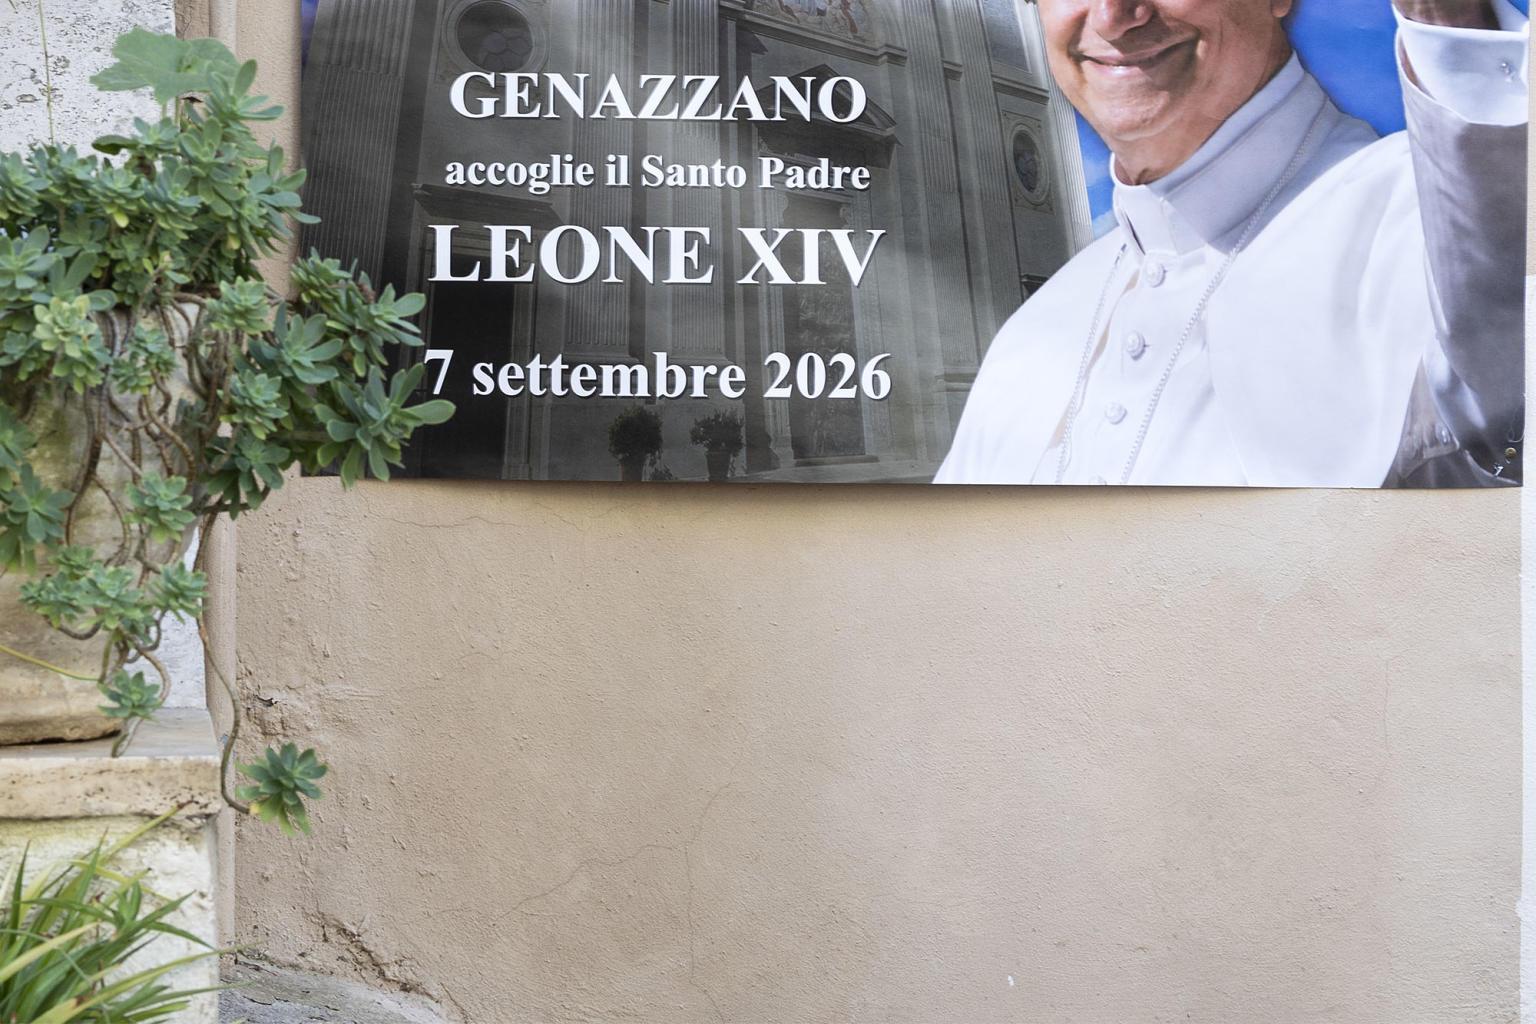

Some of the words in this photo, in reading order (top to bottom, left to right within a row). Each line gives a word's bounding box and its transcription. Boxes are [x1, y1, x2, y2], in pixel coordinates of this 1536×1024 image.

[450, 71, 866, 123] GENAZZANO
[445, 153, 594, 195] accoglie
[605, 154, 630, 186] il
[642, 154, 747, 188] Santo
[758, 157, 870, 190] Padre
[428, 224, 714, 284] LEONE
[736, 227, 886, 287] XIV
[424, 349, 454, 395] 7
[473, 351, 746, 398] settembre
[763, 352, 891, 400] 2026
